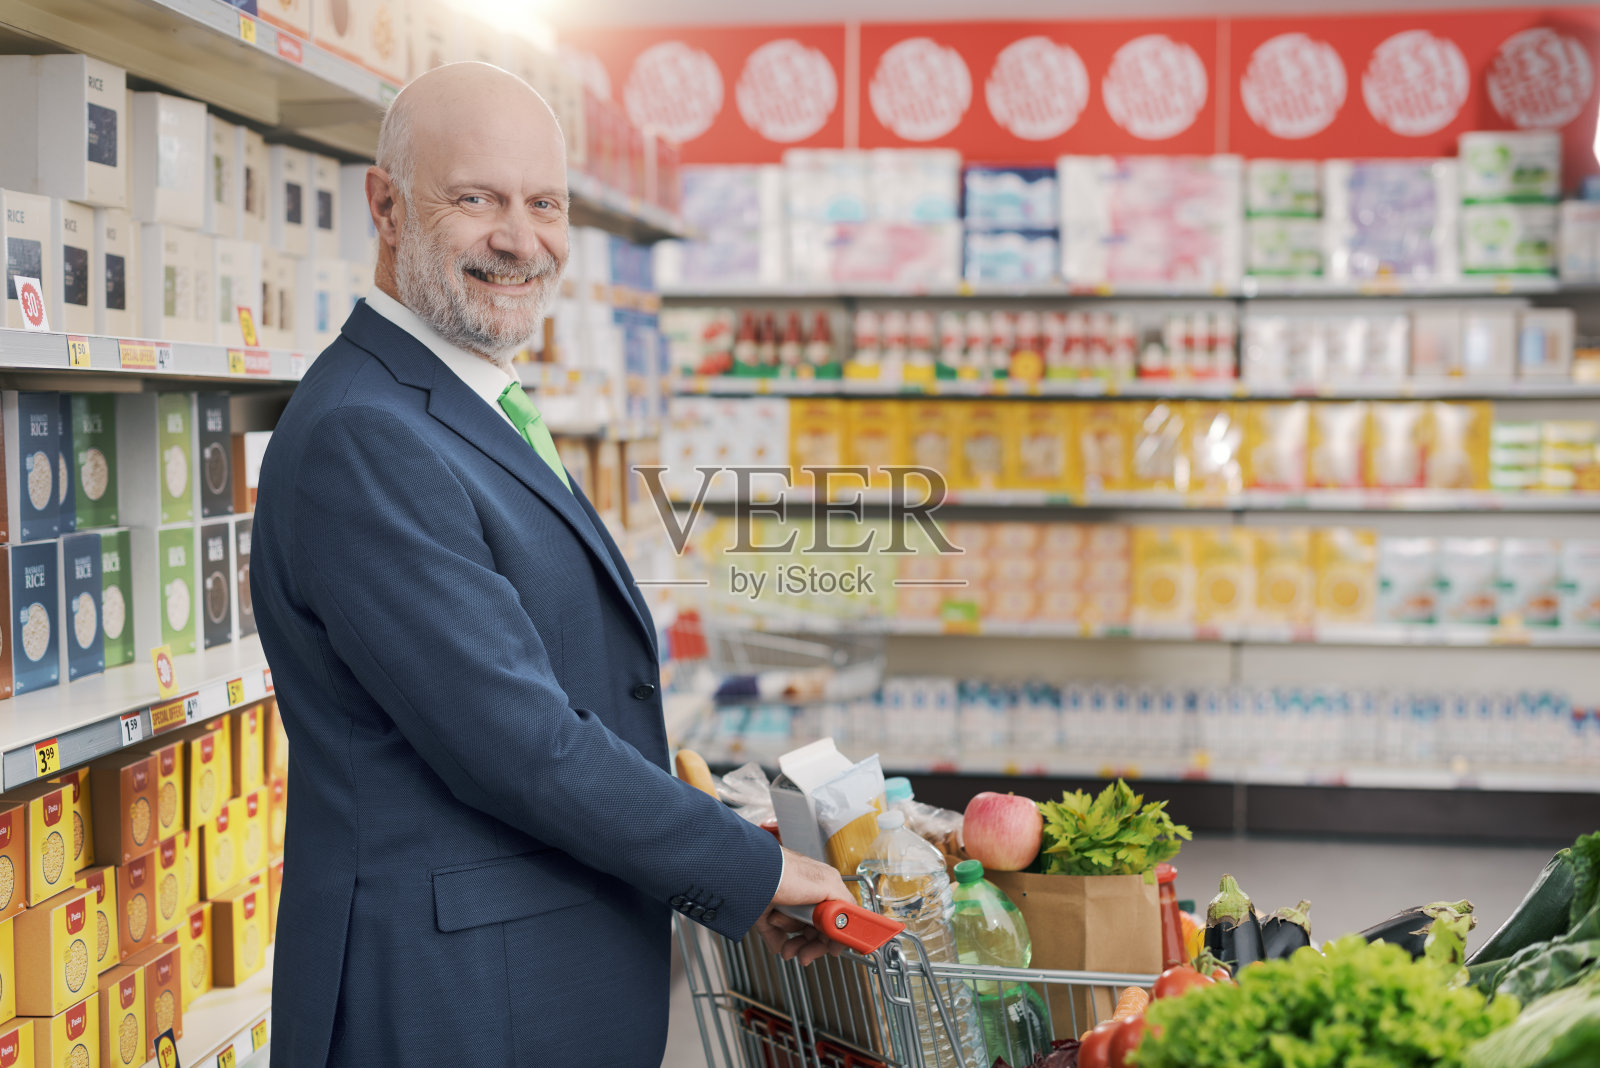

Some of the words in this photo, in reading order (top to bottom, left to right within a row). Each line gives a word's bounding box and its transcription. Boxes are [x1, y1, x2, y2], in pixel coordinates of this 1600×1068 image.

[88, 75, 103, 92] RICE
[7, 208, 25, 224] RICE
[64, 218, 78, 233] RICE
[30, 422, 49, 437] RICE
[75, 563, 92, 580] RICE
[25, 573, 45, 589] RICE
[152, 706, 169, 726] SPECIAL
[169, 703, 184, 720] OFFERS
[124, 718, 138, 742] 1.59
[38, 746, 55, 774] 3.99
[48, 804, 58, 814] Pasta
[70, 911, 82, 923] Pasta
[71, 1016, 82, 1028] Pasta
[1, 1044, 14, 1057] Pasta
